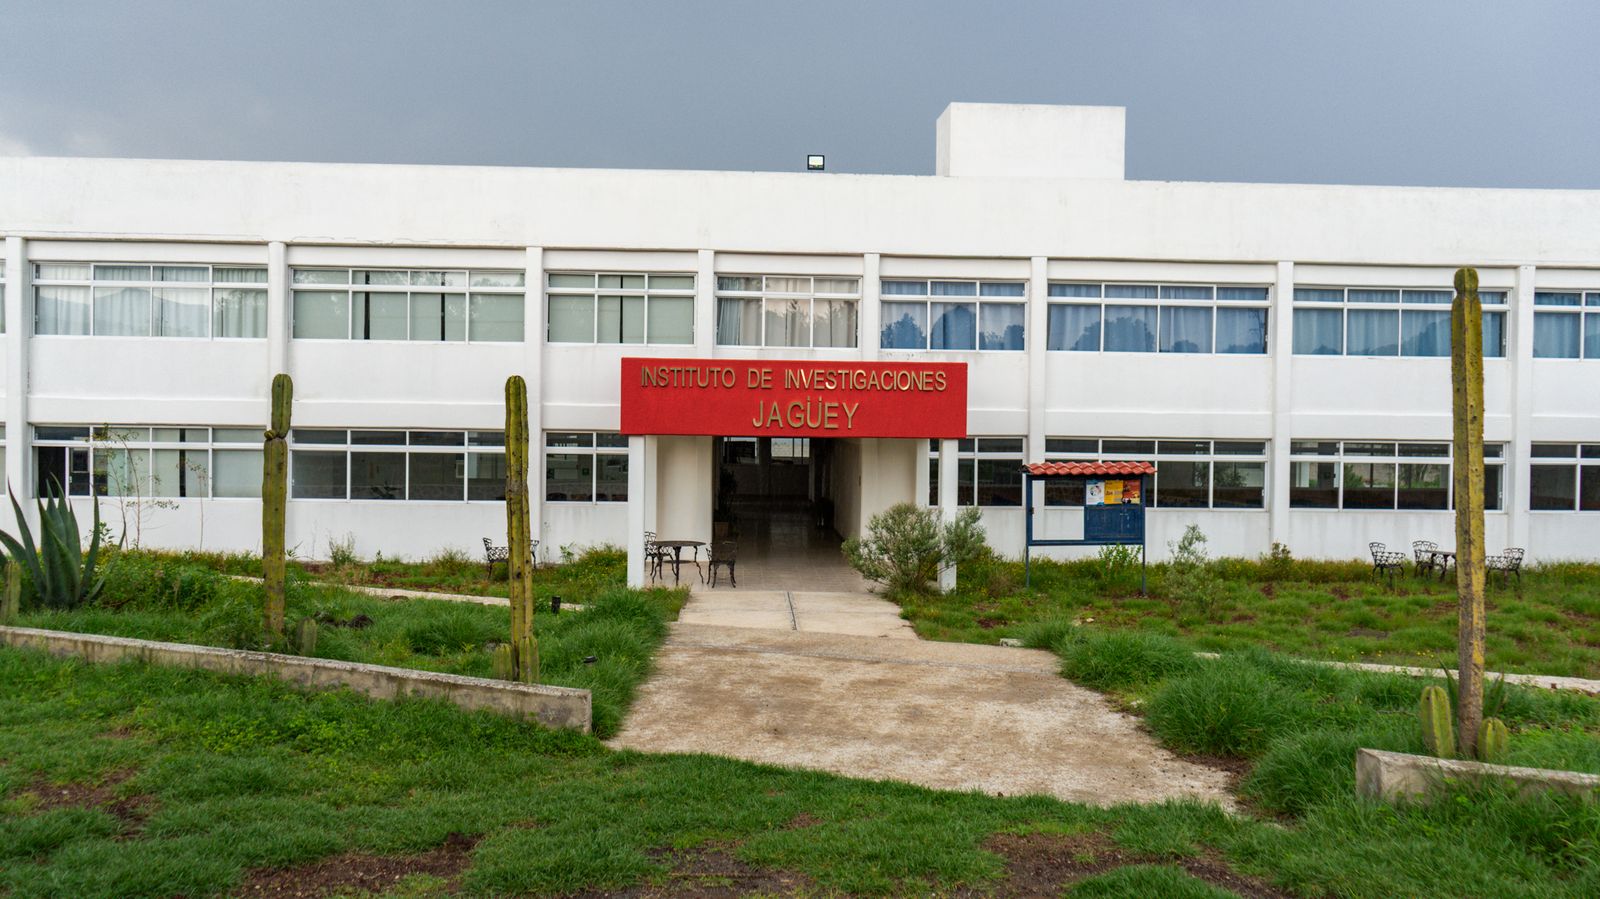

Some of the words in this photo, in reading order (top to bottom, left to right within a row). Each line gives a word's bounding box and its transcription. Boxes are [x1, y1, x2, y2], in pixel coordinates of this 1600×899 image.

[641, 366, 735, 388] INSTITUTO
[747, 368, 772, 389] DE
[785, 369, 947, 391] INVESTIGACIONES
[752, 396, 860, 429] JAGÜEY
